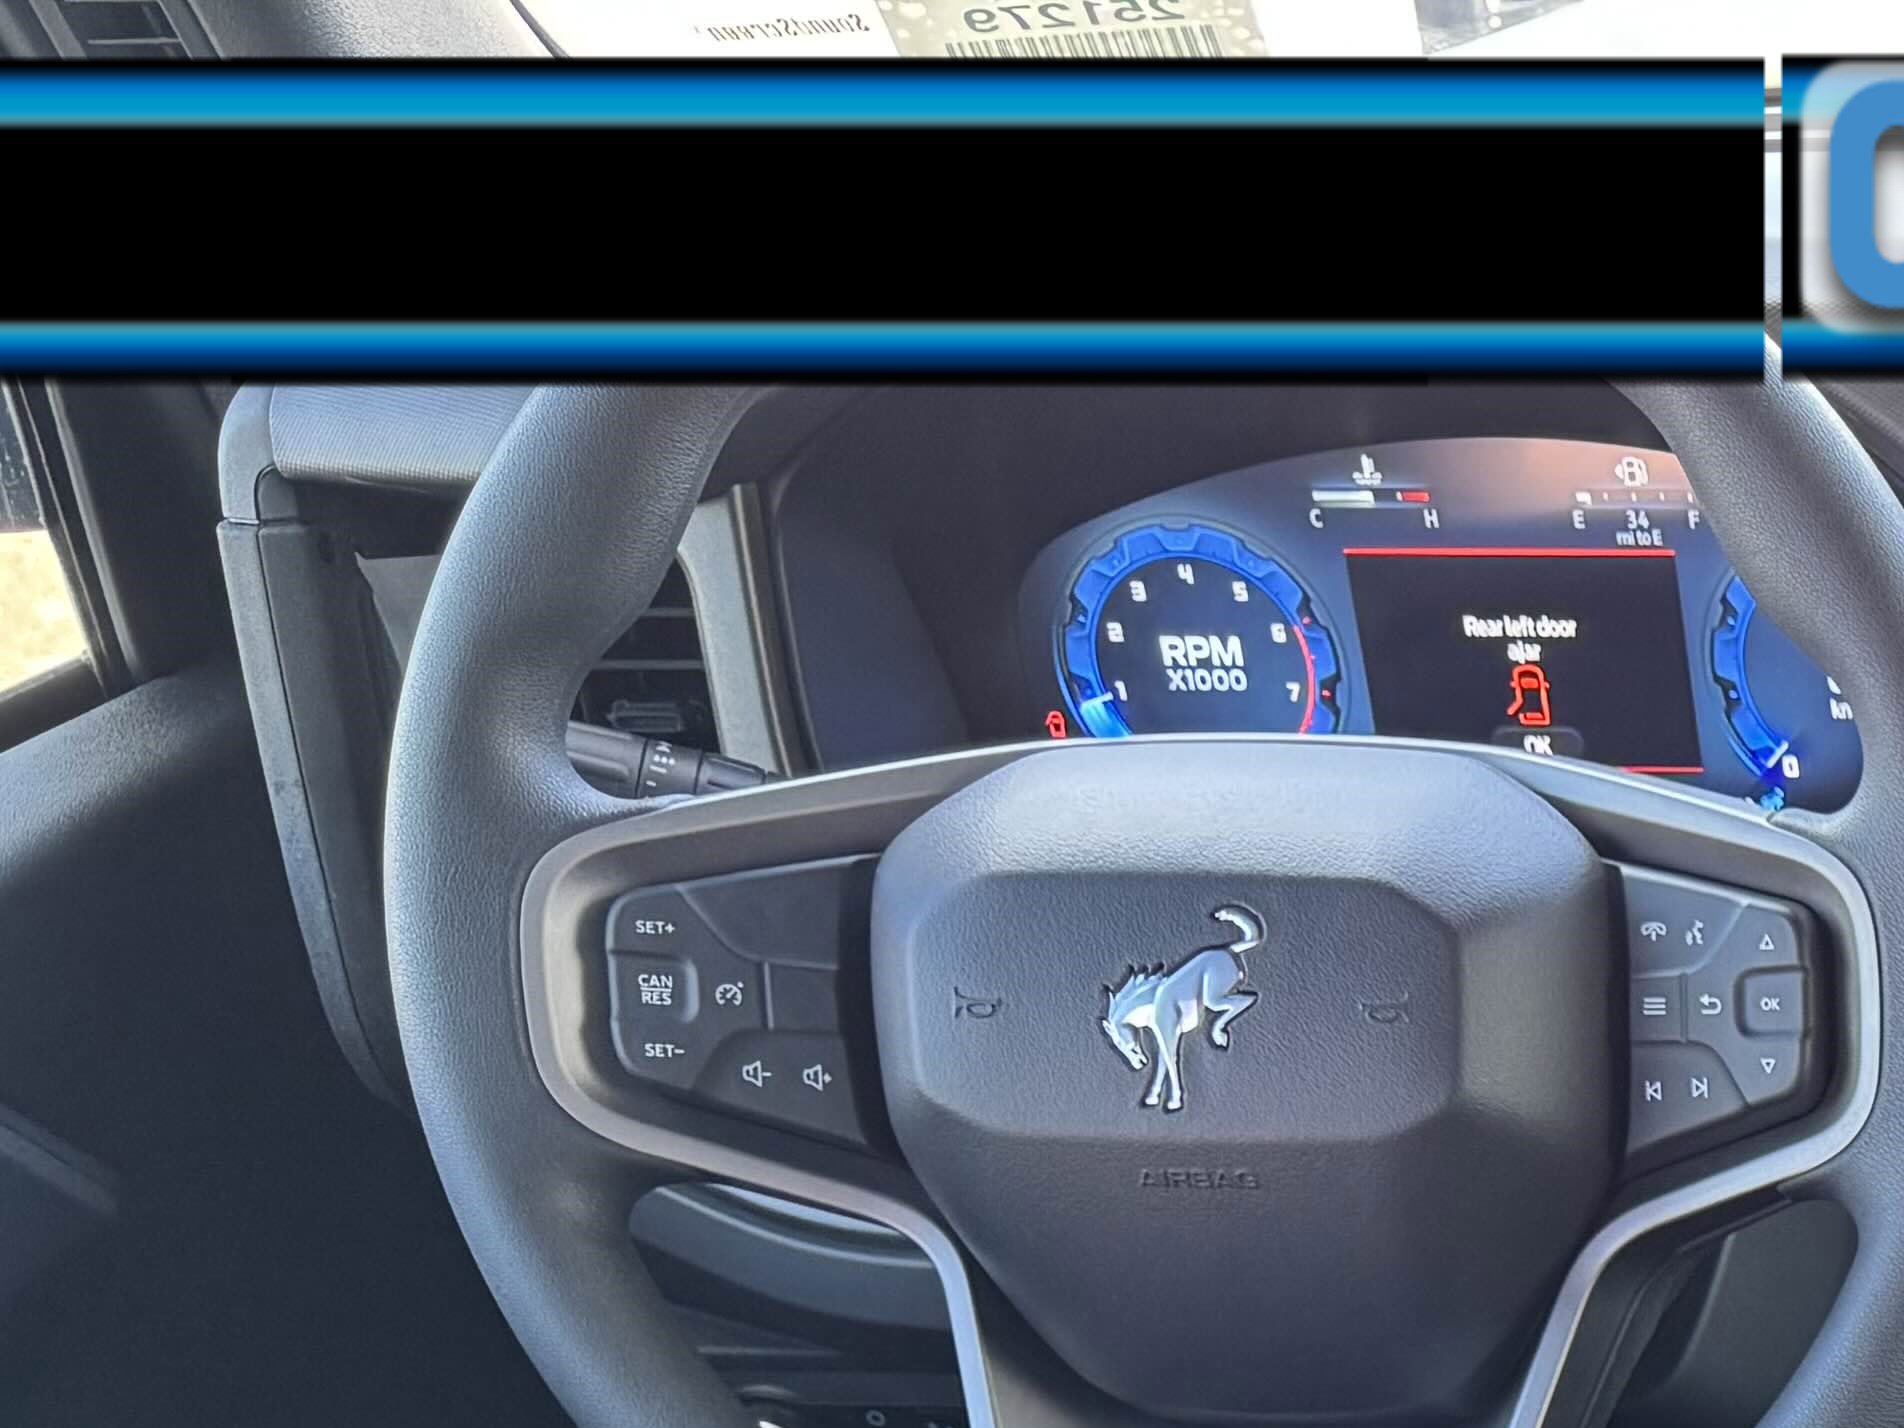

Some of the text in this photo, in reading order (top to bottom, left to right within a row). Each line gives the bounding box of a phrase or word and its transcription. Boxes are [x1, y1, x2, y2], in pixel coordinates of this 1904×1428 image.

[1309, 508, 1323, 528] C
[1423, 509, 1439, 528] H
[1573, 510, 1585, 529] E
[1626, 510, 1650, 529] 34
[1688, 510, 1701, 529] F
[1616, 530, 1663, 546] mi to E
[1177, 564, 1195, 585] 4
[1129, 580, 1147, 602] 3
[1232, 581, 1248, 602] 5
[1106, 621, 1124, 642] 2
[1270, 623, 1287, 643] 6
[1462, 614, 1577, 638] Rear left door
[1159, 635, 1244, 667] RPM
[1507, 640, 1541, 664] ajar
[1166, 668, 1248, 691] X1000
[1114, 680, 1128, 701] 1
[1286, 682, 1300, 702] 7
[1782, 753, 1800, 779] 0
[635, 920, 675, 935] SET+
[638, 974, 673, 989] CAN
[641, 991, 672, 1006] RES
[1760, 998, 1780, 1011] OK
[1138, 1168, 1261, 1190] AIRBAG
